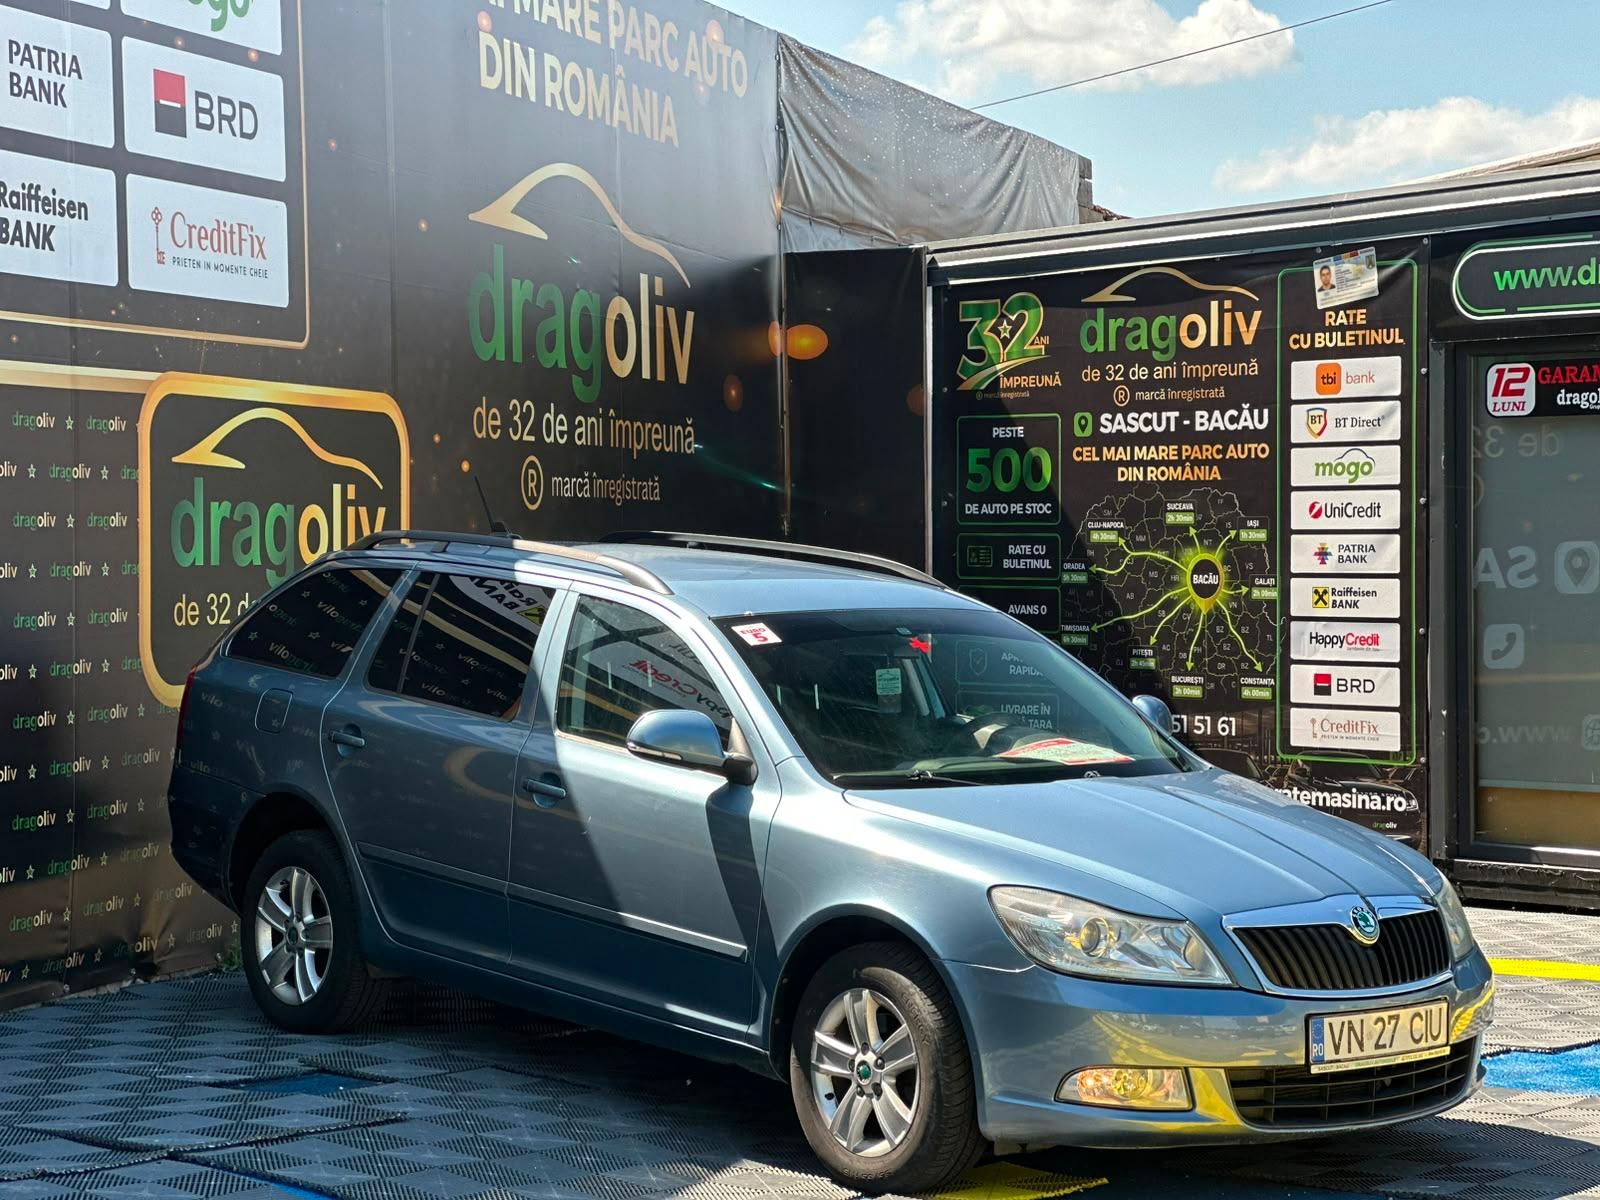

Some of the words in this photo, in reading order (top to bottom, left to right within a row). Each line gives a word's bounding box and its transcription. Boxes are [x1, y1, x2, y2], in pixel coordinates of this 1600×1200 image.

[608, 0, 680, 73] PARC
[684, 29, 749, 98] AUTO
[8, 39, 84, 81] PATRIA
[9, 71, 68, 109] BANK
[478, 31, 537, 104] DIN
[543, 52, 680, 149] ROMÂNIA
[194, 90, 260, 141] BRD
[170, 211, 268, 261] CreditFix
[172, 256, 202, 270] PRIETEN
[203, 261, 212, 271] IN
[213, 263, 248, 276] MOMENTE
[249, 267, 269, 279] CHEIE
[1493, 256, 1600, 291] www.d
[467, 243, 696, 404] dragoliv
[1324, 308, 1367, 327] RATE
[956, 291, 1046, 381] 32
[1034, 336, 1050, 345] ANI
[1079, 299, 1263, 362] dragoliv
[1288, 334, 1311, 350] CU
[1314, 327, 1404, 349] BULETINUL
[1000, 371, 1062, 389] ÎMPREUNĂ
[1081, 365, 1101, 382] de
[1105, 364, 1125, 381] 32
[1129, 363, 1149, 380] de
[1153, 363, 1177, 379] ani
[1182, 359, 1259, 382] împreună
[1321, 372, 1337, 385] tbi
[1345, 370, 1376, 385] bank
[1491, 367, 1531, 397] 12
[1135, 387, 1166, 401] marcă
[1167, 386, 1226, 404] înregistrată
[1493, 400, 1527, 412] LUNI
[12, 411, 55, 431] dragoliv
[86, 415, 127, 434] dragoliv
[473, 396, 502, 440] de
[508, 399, 536, 442] 32
[542, 402, 568, 445] de
[574, 407, 603, 447] ani
[609, 408, 696, 460] împreună
[1099, 411, 1180, 434] SASCUT
[1194, 403, 1269, 432] BACĂU
[1310, 415, 1323, 425] BT
[1335, 417, 1348, 428] BT
[1350, 416, 1382, 428] Direct
[992, 427, 1024, 438] PESTE
[1072, 446, 1100, 462] CEL
[1103, 445, 1131, 462] MAI
[1134, 444, 1179, 461] MARE
[1182, 444, 1223, 461] PARC
[1226, 443, 1270, 460] AUTO
[49, 463, 91, 482] dragoliv
[966, 447, 1052, 493] 500
[1117, 466, 1145, 482] DIN
[1148, 462, 1221, 482] ROMÂNIA
[1314, 458, 1374, 484] mogo
[551, 472, 592, 499] marcă
[592, 474, 662, 507] înregistrată
[965, 504, 979, 515] DE
[980, 503, 1009, 515] AUTO
[1010, 503, 1024, 514] PE
[1025, 502, 1052, 514] STOC
[1324, 502, 1382, 519] UniCredit
[12, 512, 56, 531] dragoliv
[87, 512, 128, 530] dragoliv
[1087, 521, 1125, 529] CLUJ-NAPOCA
[1008, 545, 1030, 555] RATE
[1031, 544, 1046, 555] CU
[1337, 544, 1377, 554] PATRIA
[1337, 554, 1368, 564] BANK
[50, 560, 92, 581] dragoliv
[1003, 558, 1052, 569] BULETINUL
[1192, 572, 1219, 585] BACĂU
[1331, 587, 1377, 598] Raiffeisen
[173, 593, 200, 627] de
[206, 592, 231, 626] 32
[1008, 604, 1038, 615] AVANS
[1331, 599, 1360, 609] BANK
[13, 611, 57, 631] dragoliv
[87, 608, 129, 627] dragoliv
[752, 632, 769, 642] 5
[1309, 632, 1380, 649] HappyCredit
[49, 658, 92, 679] dragoliv
[1336, 678, 1376, 693] BRD
[13, 711, 57, 731] dragoliv
[88, 704, 128, 723] dragoliv
[1001, 704, 1039, 715] LIVRARE
[1040, 702, 1051, 715] ÎN
[1193, 715, 1211, 736] 51
[1217, 716, 1236, 737] 61
[1320, 718, 1379, 735] CreditFix
[49, 756, 92, 777] dragoliv
[121, 748, 161, 767] dragoliv
[1273, 787, 1408, 812] atemasina.ro
[11, 810, 57, 831] dragoliv
[87, 800, 128, 819] dragoliv
[47, 854, 90, 875] dragoliv
[9, 910, 53, 933] dragoliv
[1328, 1018, 1365, 1056] VN
[1373, 1014, 1400, 1050] 27
[1409, 1007, 1443, 1045] CIU
[1312, 1043, 1324, 1057] RO
